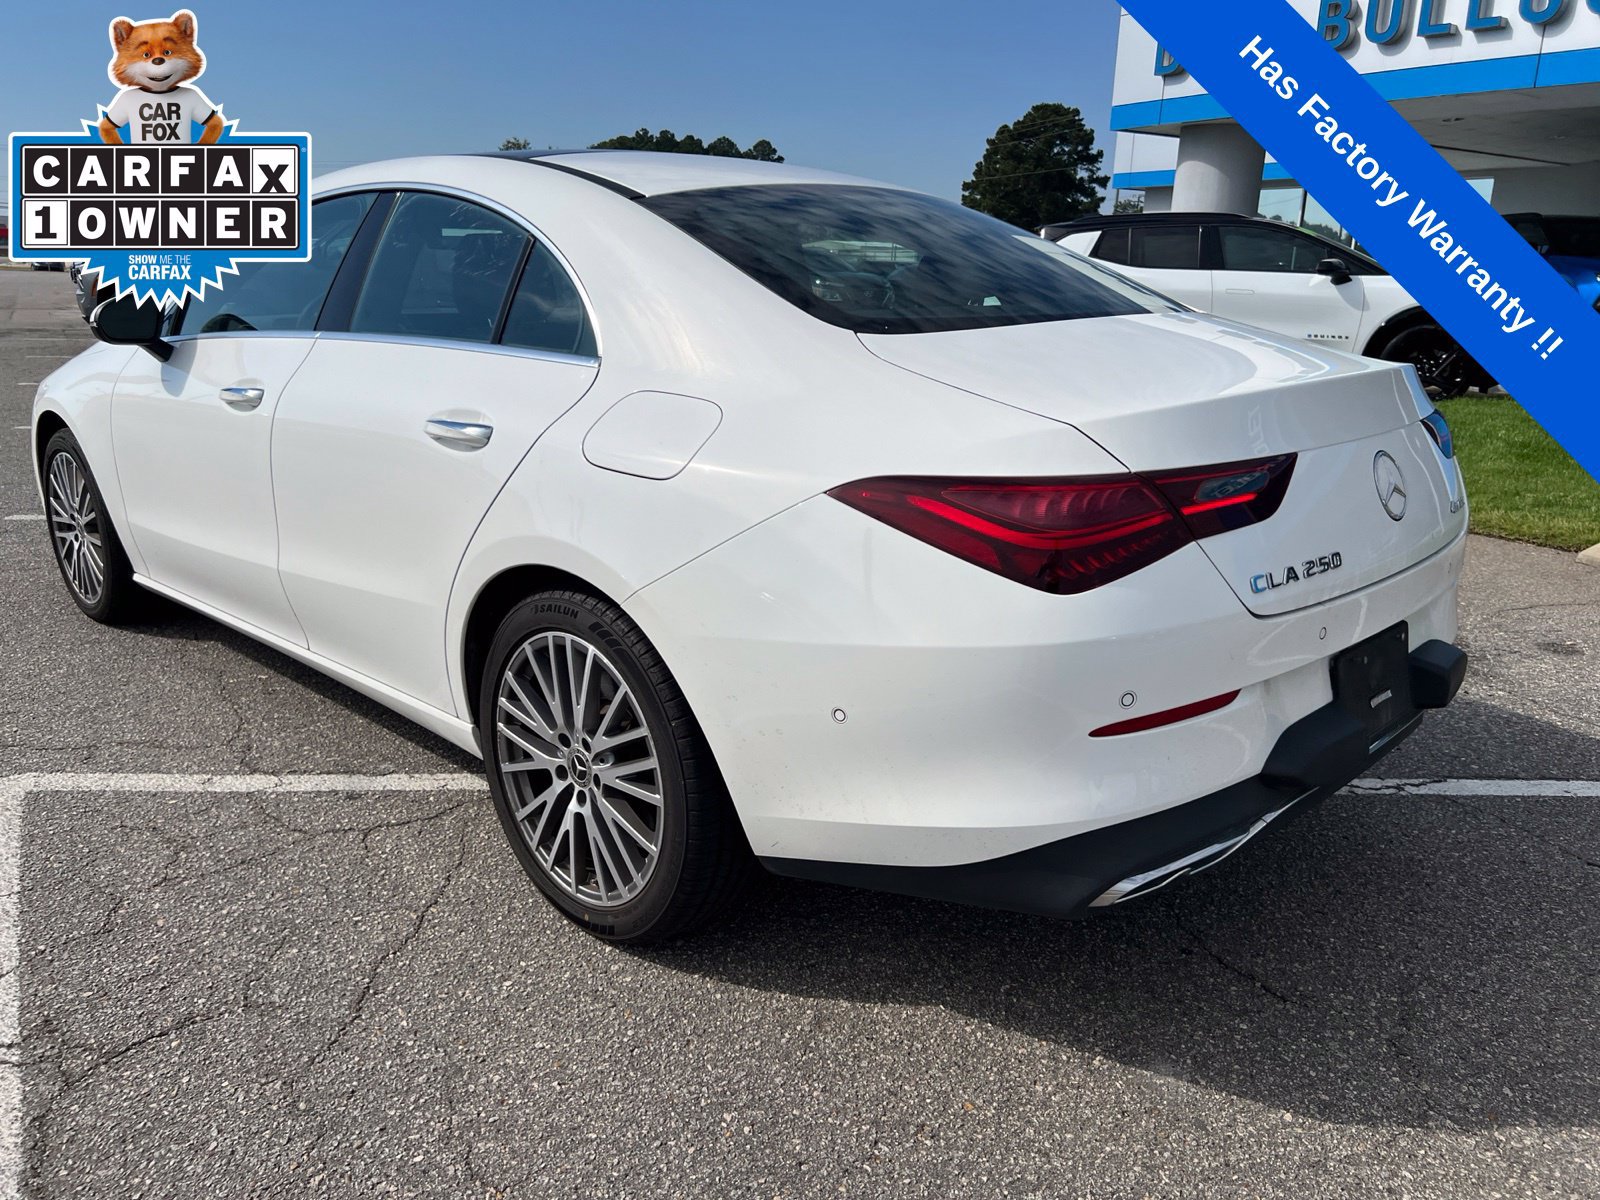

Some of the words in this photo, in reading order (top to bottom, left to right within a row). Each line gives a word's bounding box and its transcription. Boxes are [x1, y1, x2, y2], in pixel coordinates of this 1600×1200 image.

[1318, 0, 1600, 51] BULL
[1249, 565, 1300, 594] CLA
[1302, 551, 1342, 579] 250
[539, 603, 580, 620] SAILUN
